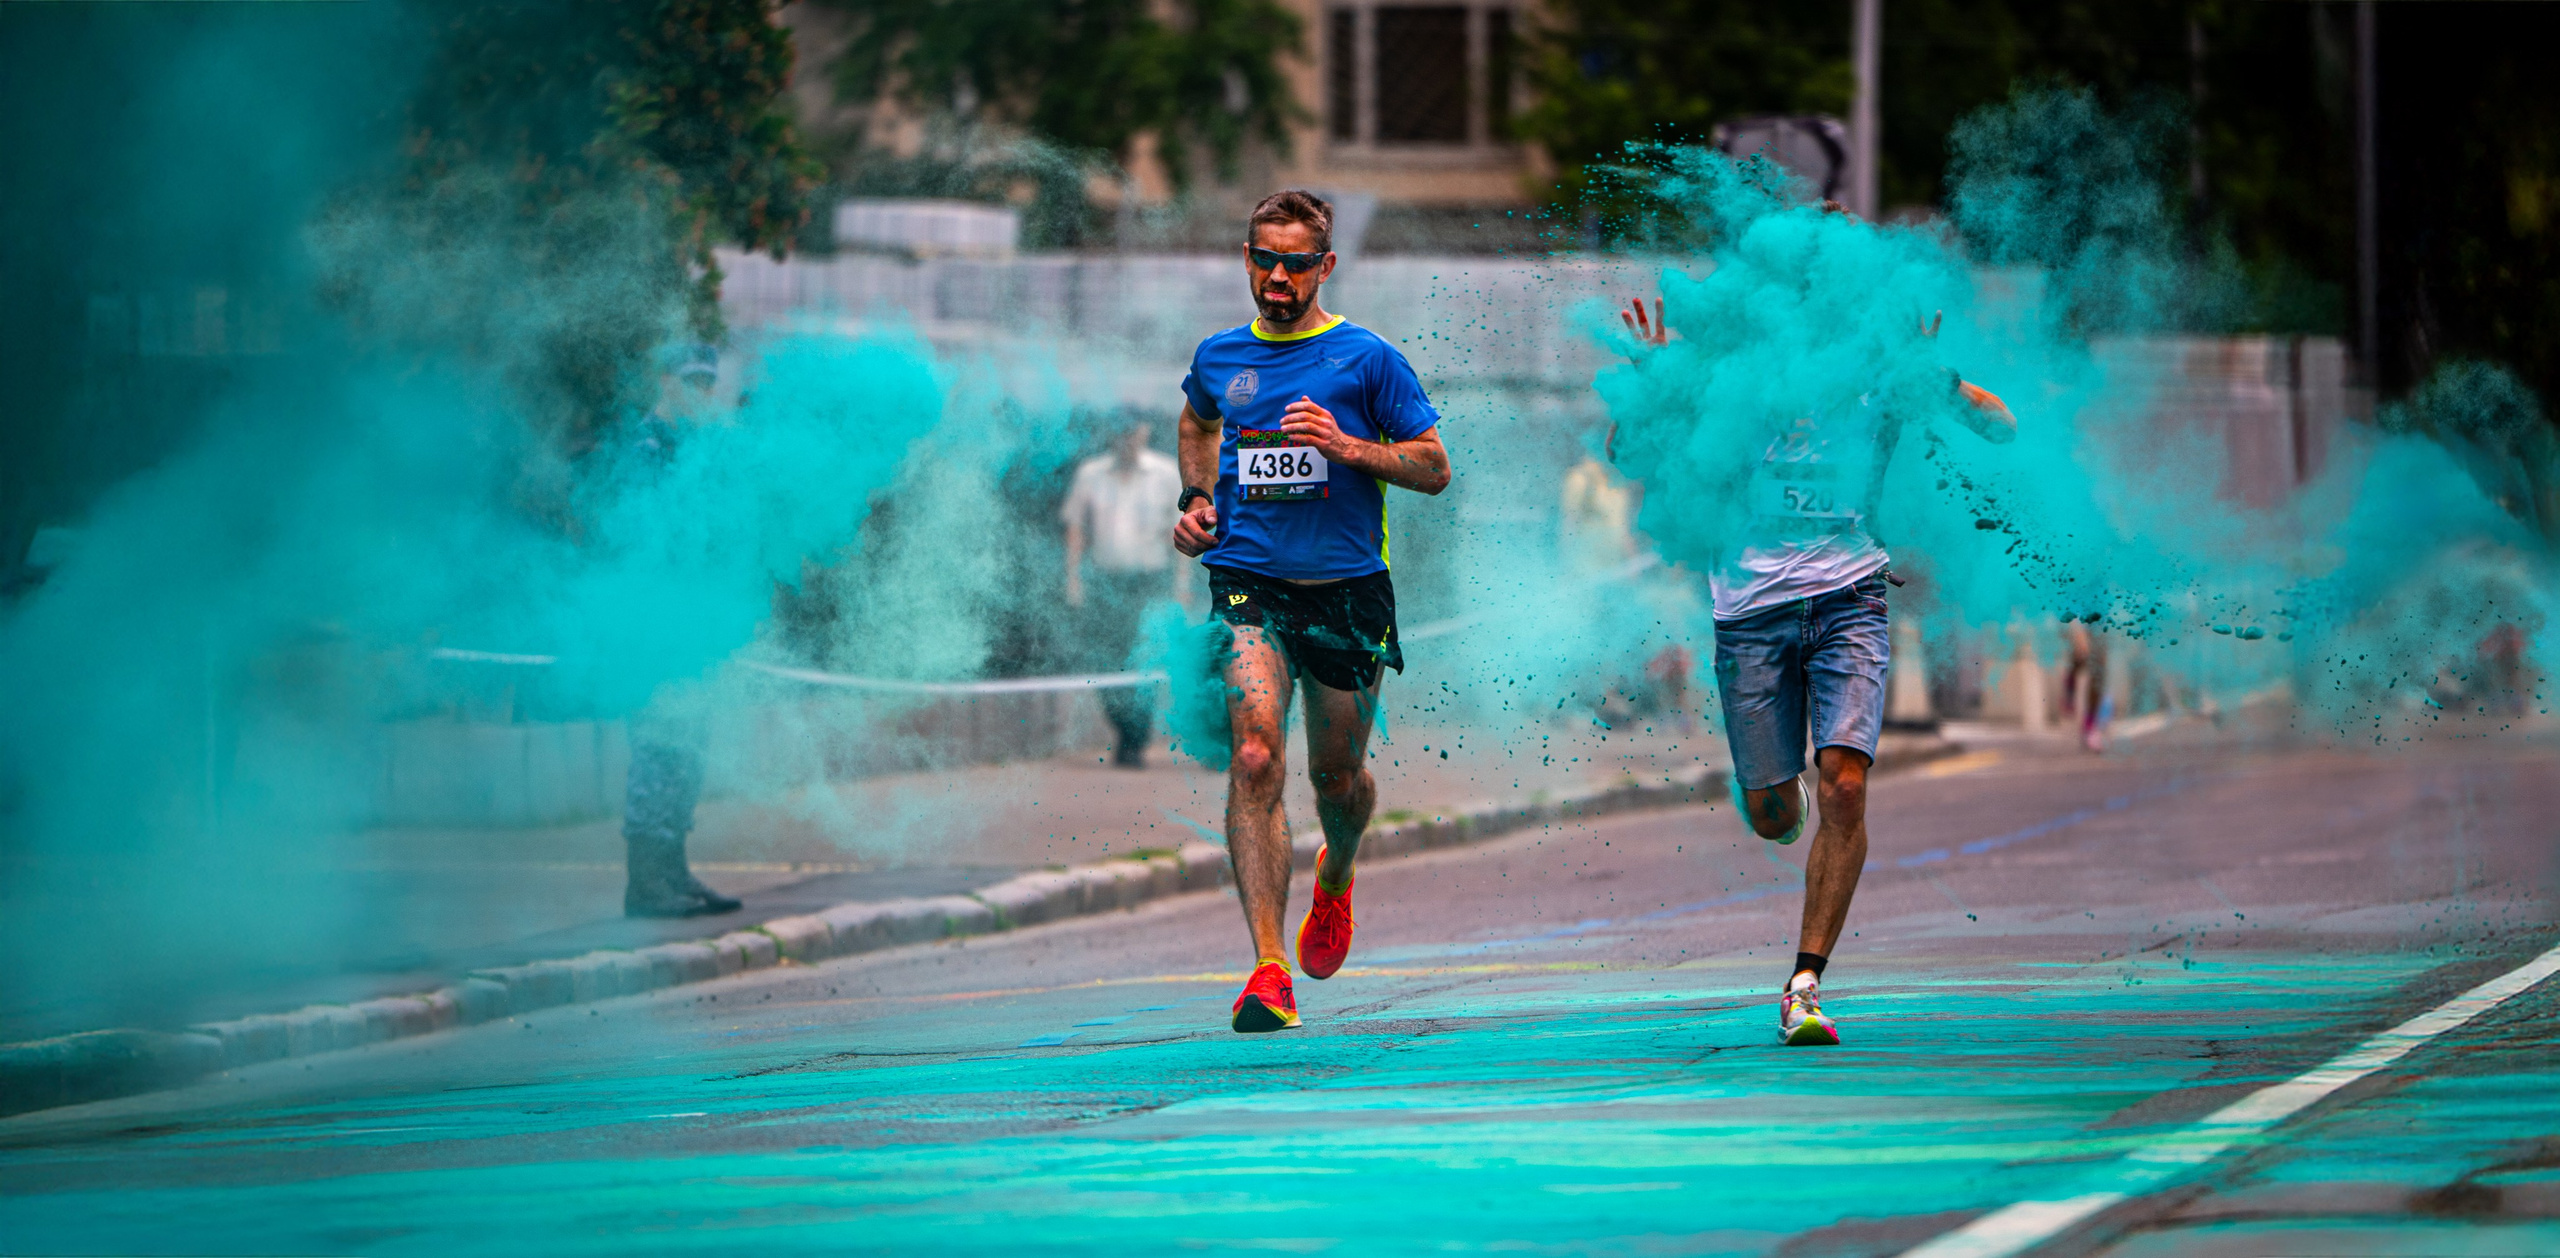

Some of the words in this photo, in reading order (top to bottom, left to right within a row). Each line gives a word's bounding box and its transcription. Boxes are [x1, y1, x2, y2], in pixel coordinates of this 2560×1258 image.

[1235, 376, 1249, 387] 21
[1249, 452, 1312, 479] 4386
[1782, 486, 1834, 513] 520
